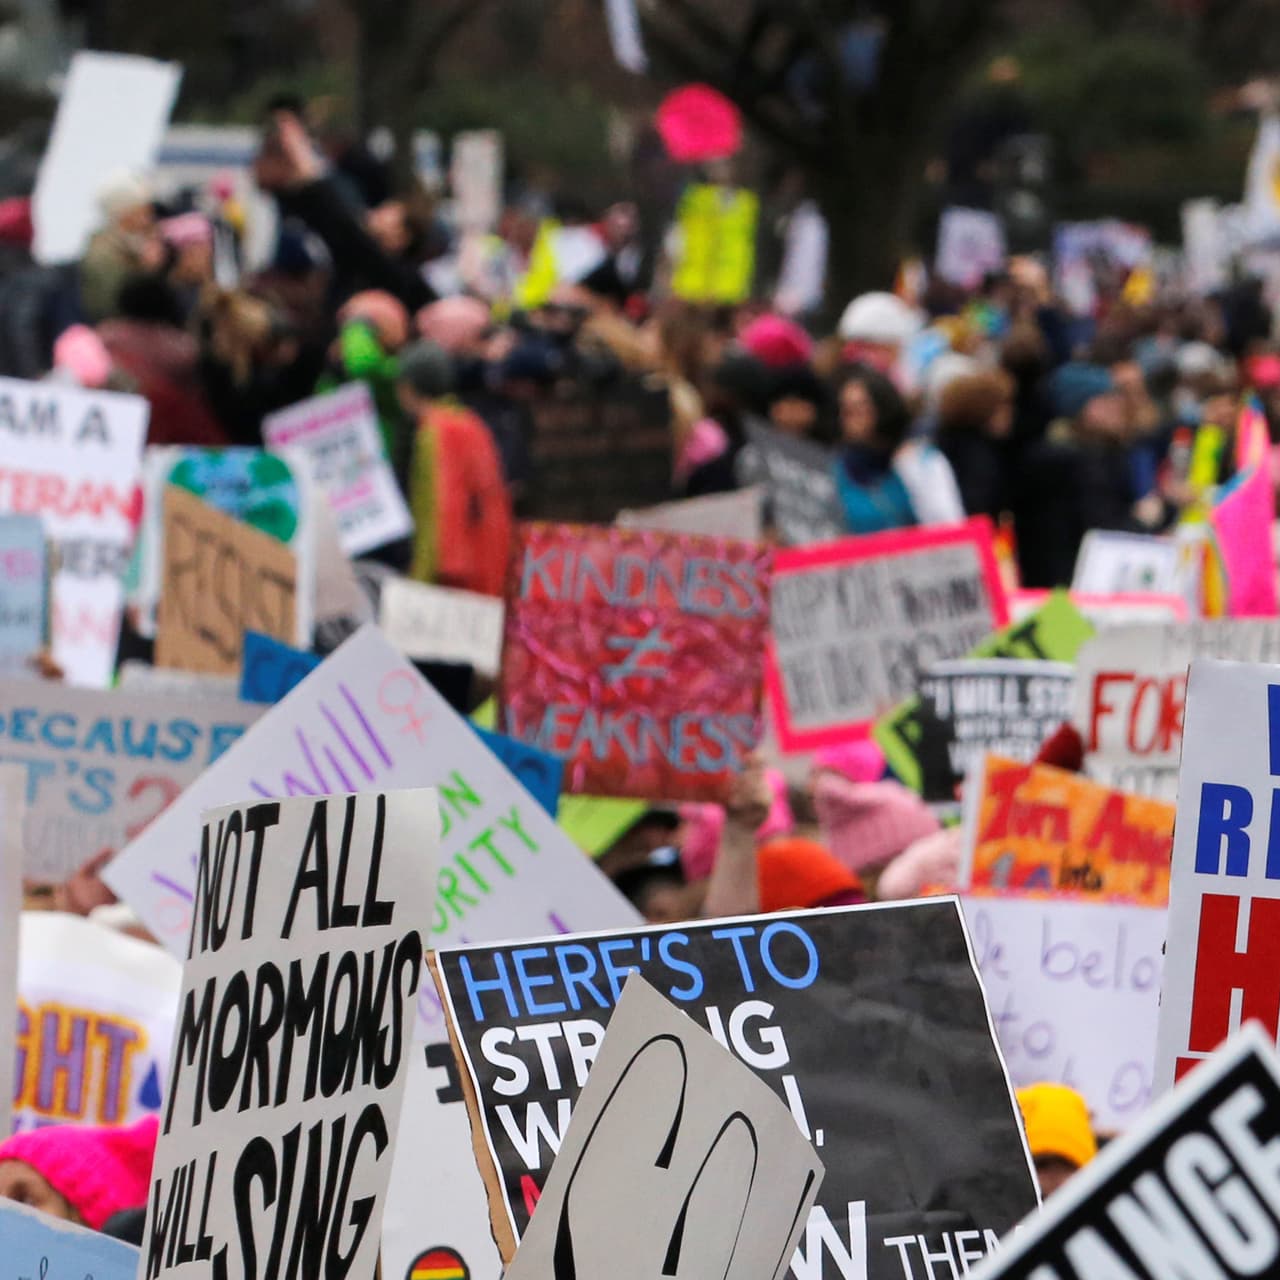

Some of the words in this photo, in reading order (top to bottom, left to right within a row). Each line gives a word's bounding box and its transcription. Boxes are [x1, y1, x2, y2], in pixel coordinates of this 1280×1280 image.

[73, 402, 110, 446] A
[521, 543, 762, 620] KINDNESS
[0, 706, 245, 768] ECAUSE
[508, 704, 762, 775] WEAKNESS
[187, 801, 281, 960] NOT
[281, 794, 396, 940] ALL
[456, 931, 704, 1025] HERE'S
[711, 920, 820, 994] TO
[162, 929, 423, 1136] MORMONS
